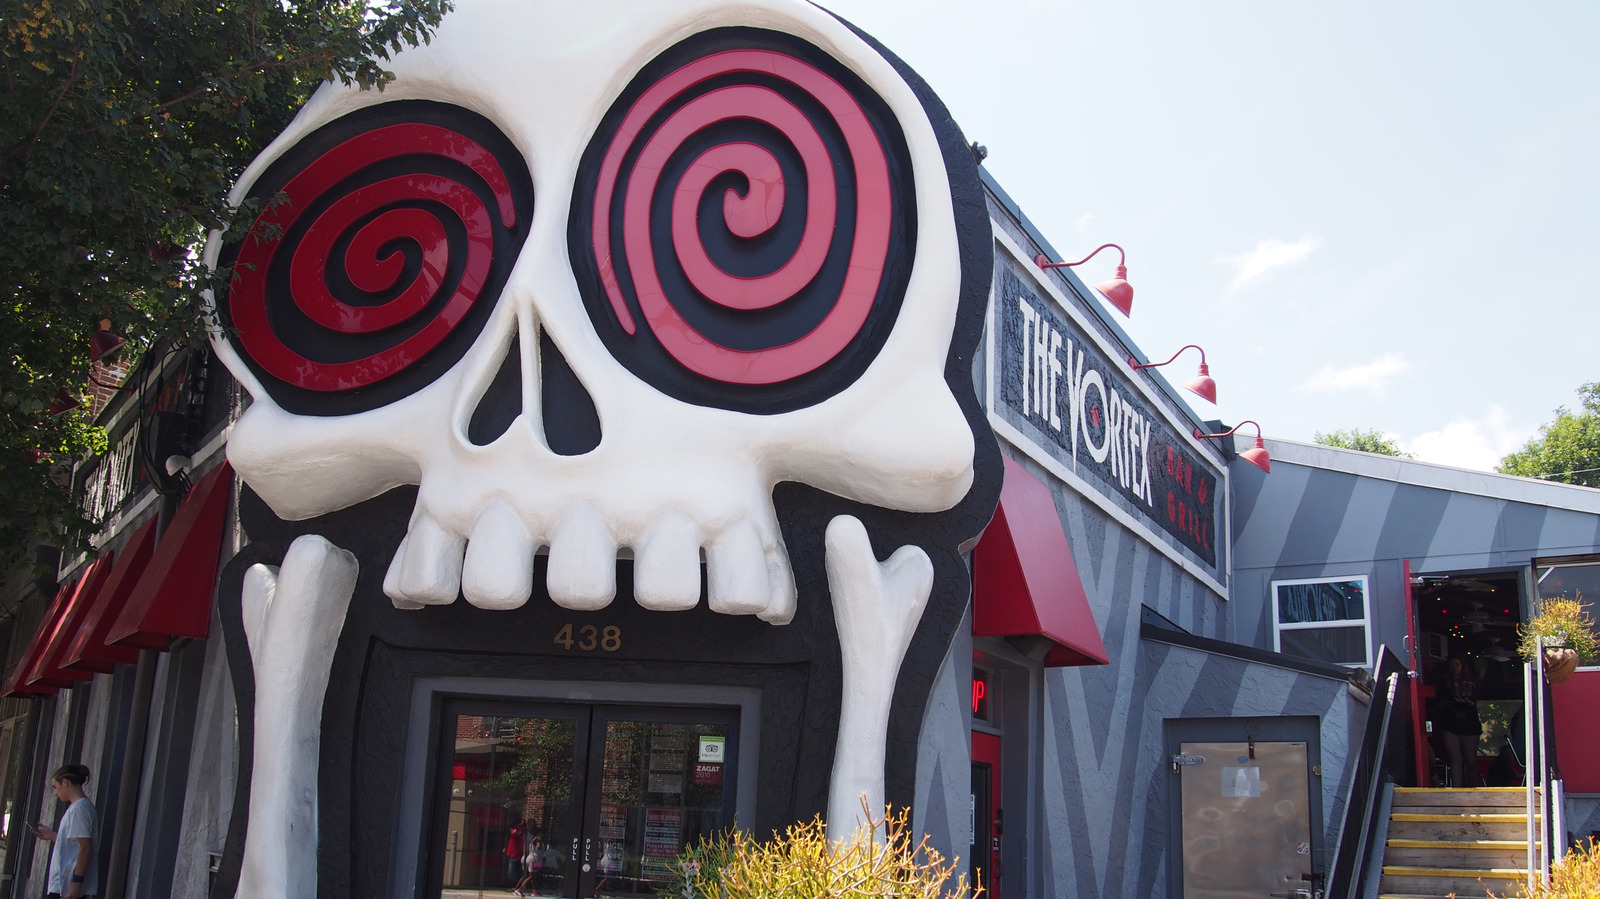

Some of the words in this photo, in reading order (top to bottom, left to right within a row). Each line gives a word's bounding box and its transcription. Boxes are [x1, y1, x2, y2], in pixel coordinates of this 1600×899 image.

[1020, 297, 1062, 431] THE
[1067, 338, 1152, 507] VORTEX
[1167, 445, 1192, 494] BAR
[1168, 491, 1208, 550] GRILL
[553, 623, 621, 652] 438
